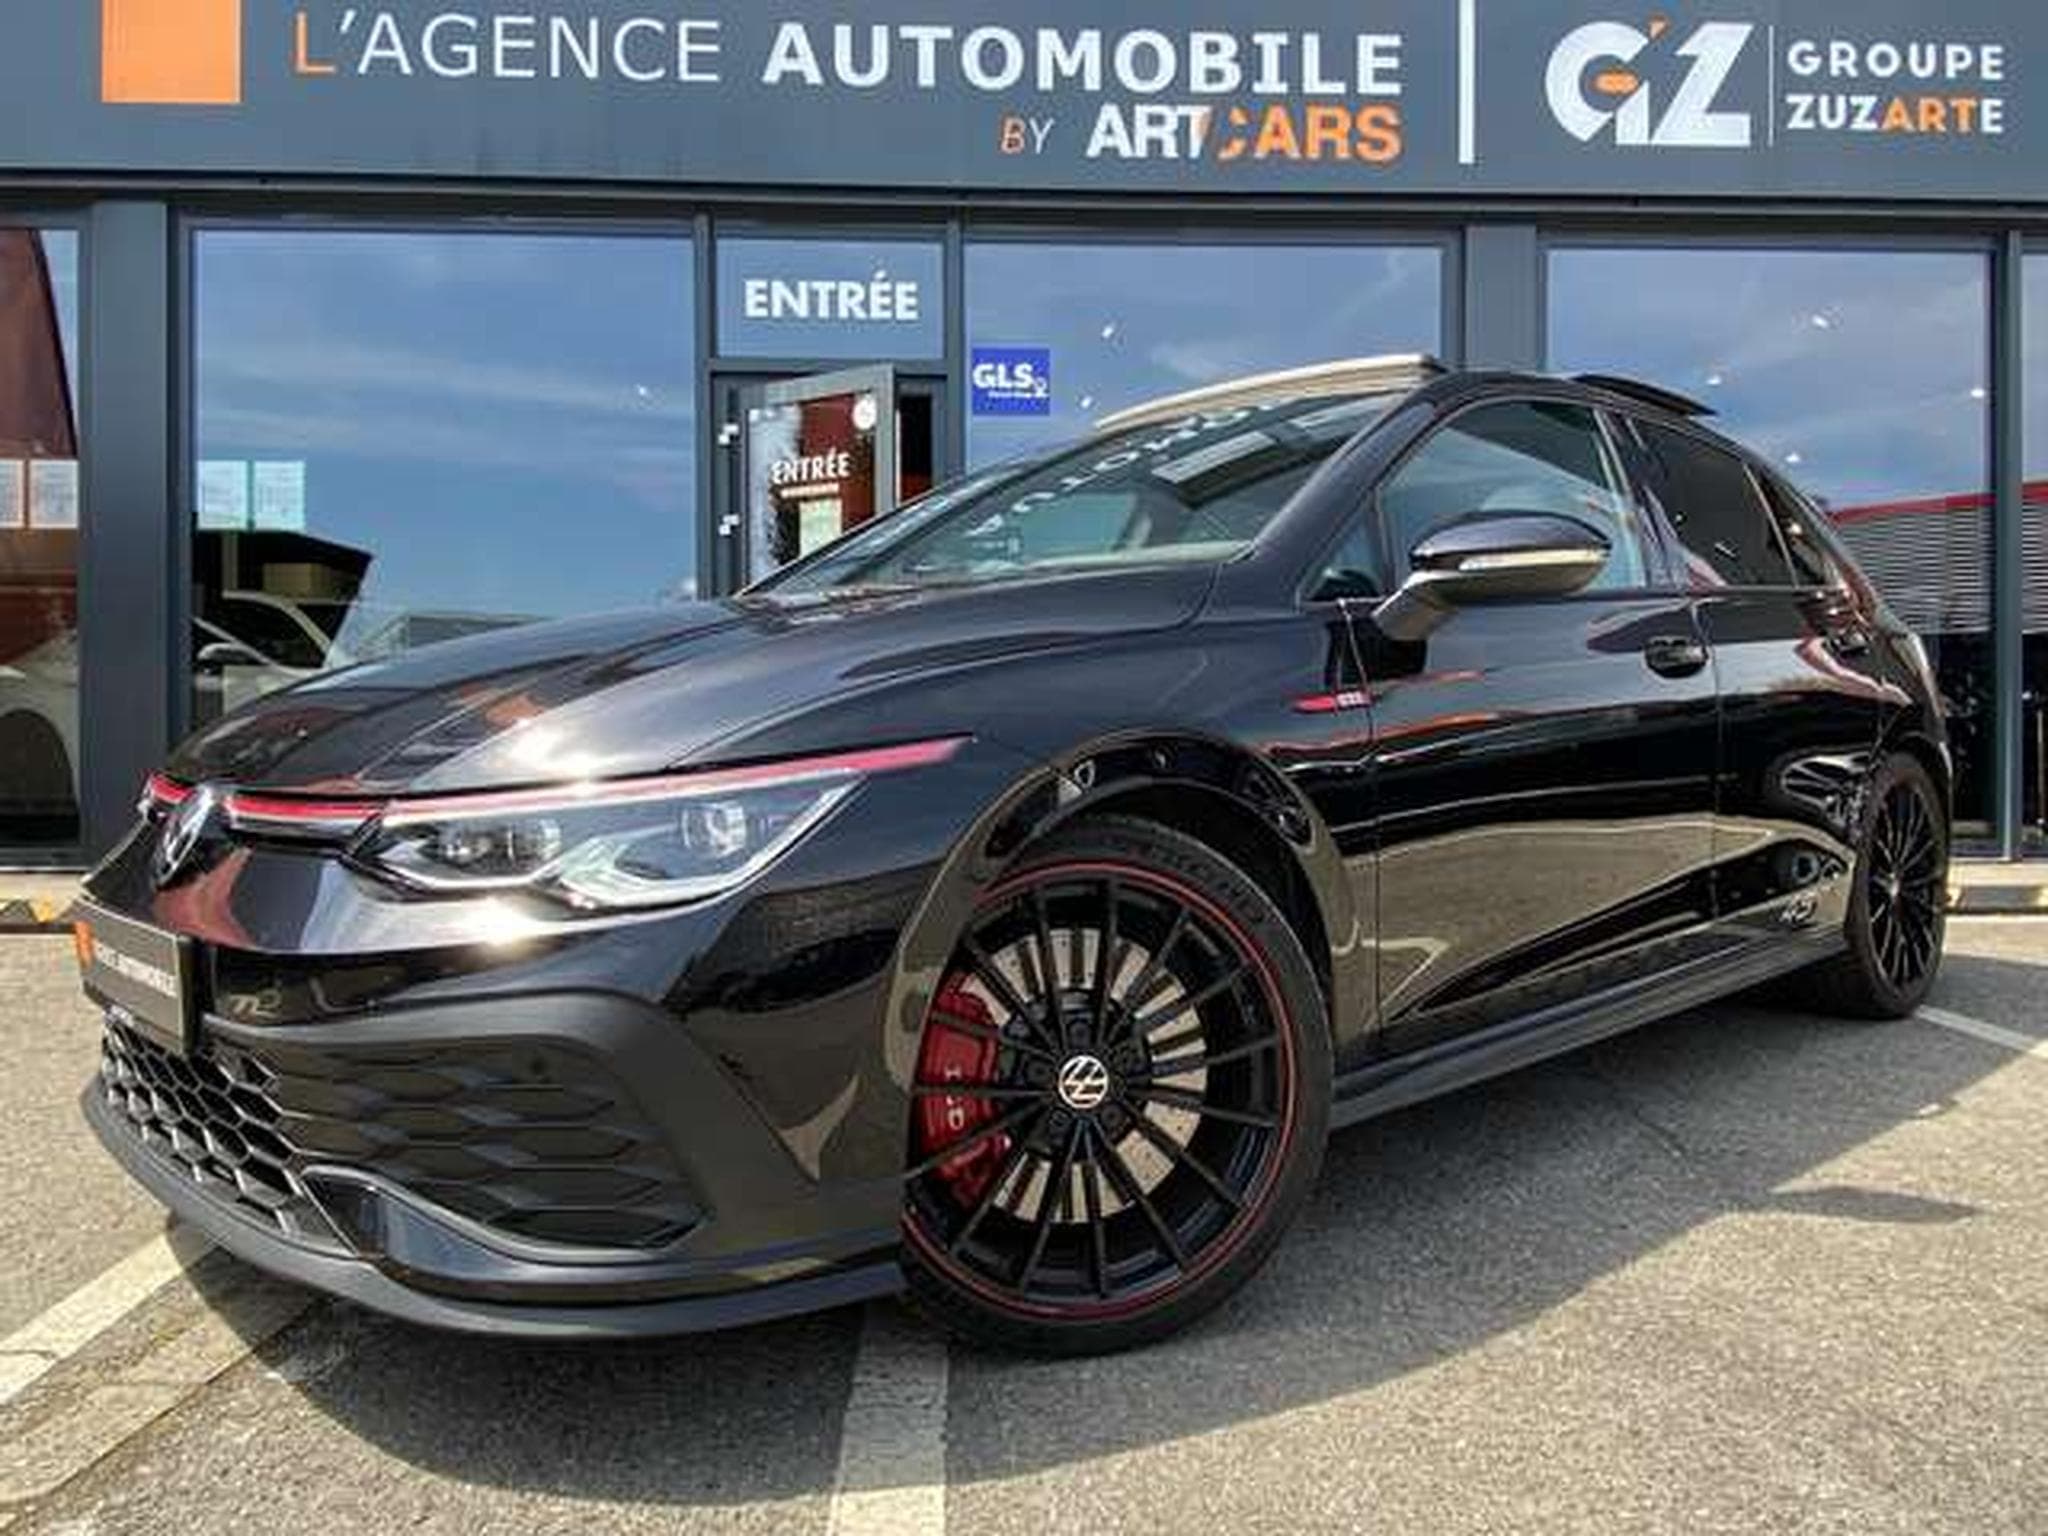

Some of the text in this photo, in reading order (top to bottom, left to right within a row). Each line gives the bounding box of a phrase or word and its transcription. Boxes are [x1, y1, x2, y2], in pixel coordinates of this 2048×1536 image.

[292, 11, 1402, 95] L'AGENCE AUTOMOBILE
[1786, 40, 2004, 80] GROUPE
[1786, 93, 2004, 134] ZUZARTE
[1001, 117, 1054, 154] BY
[743, 269, 919, 320] ENTRÉE
[973, 362, 1033, 389] GLS
[771, 446, 851, 485] ENTRÉE
